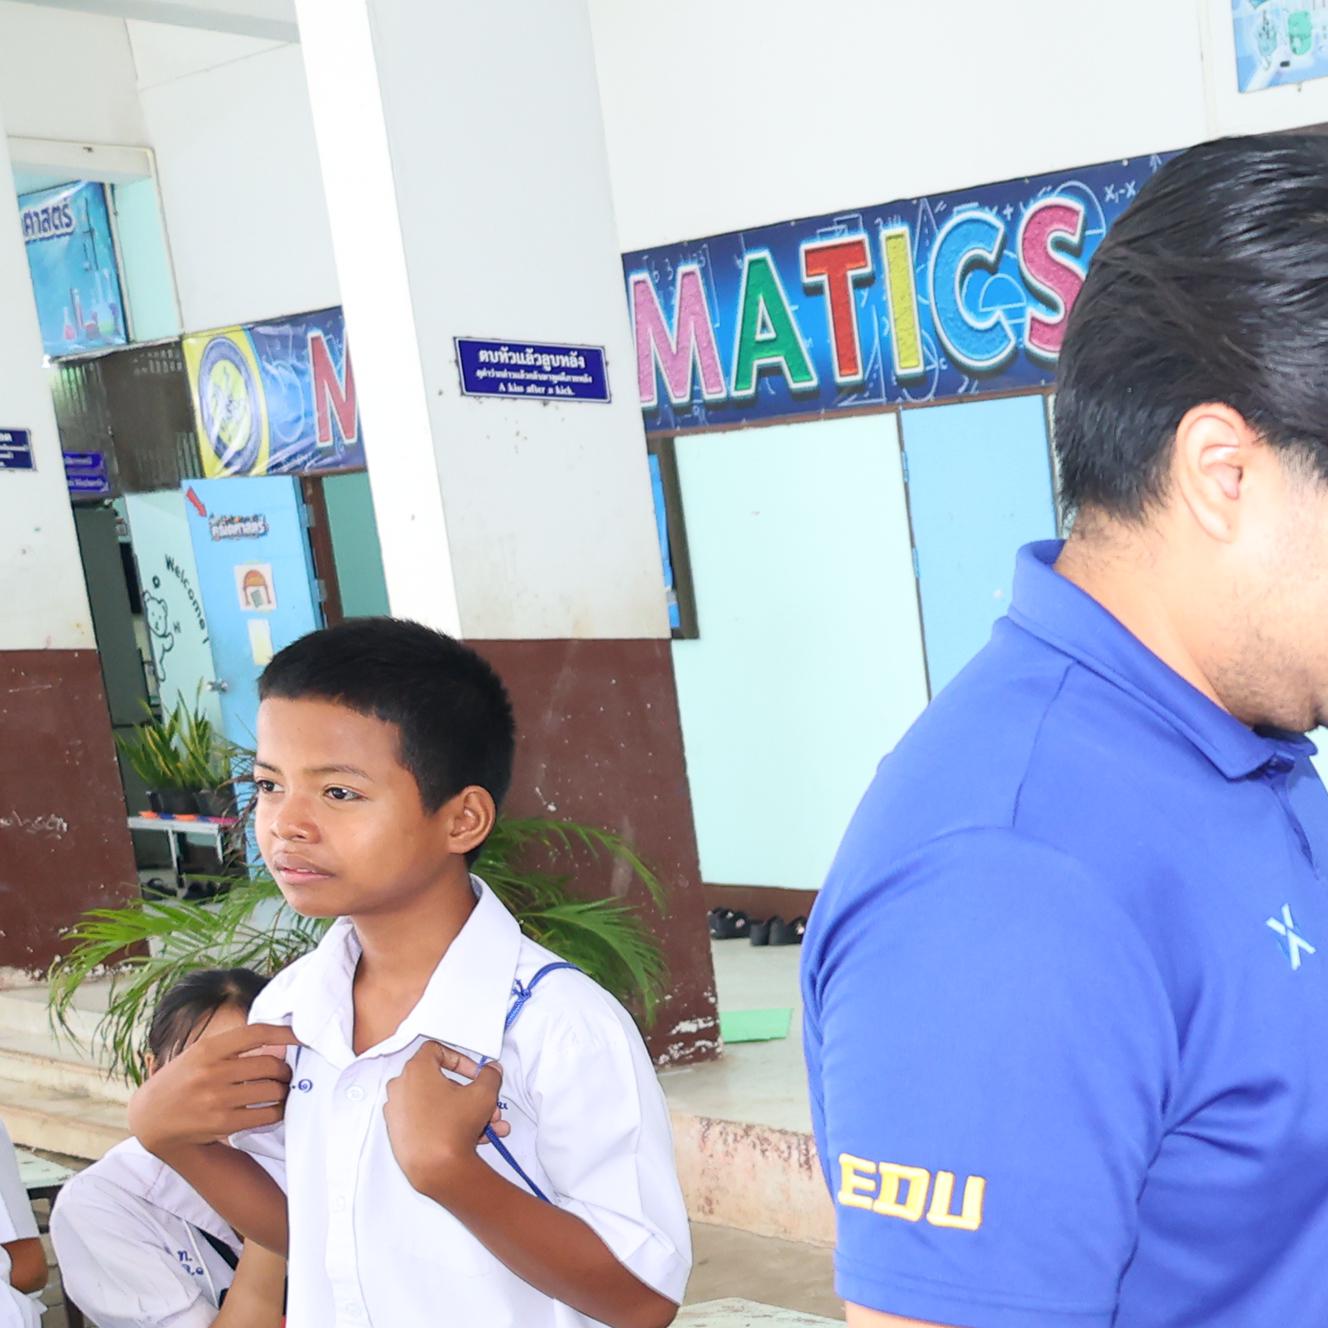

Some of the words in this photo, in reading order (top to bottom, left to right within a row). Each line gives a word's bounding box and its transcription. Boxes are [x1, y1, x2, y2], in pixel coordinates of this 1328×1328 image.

[479, 346, 585, 371] ตบหัวแล้วลูบหลัง
[526, 384, 546, 395] after
[837, 1152, 987, 1232] EDU
